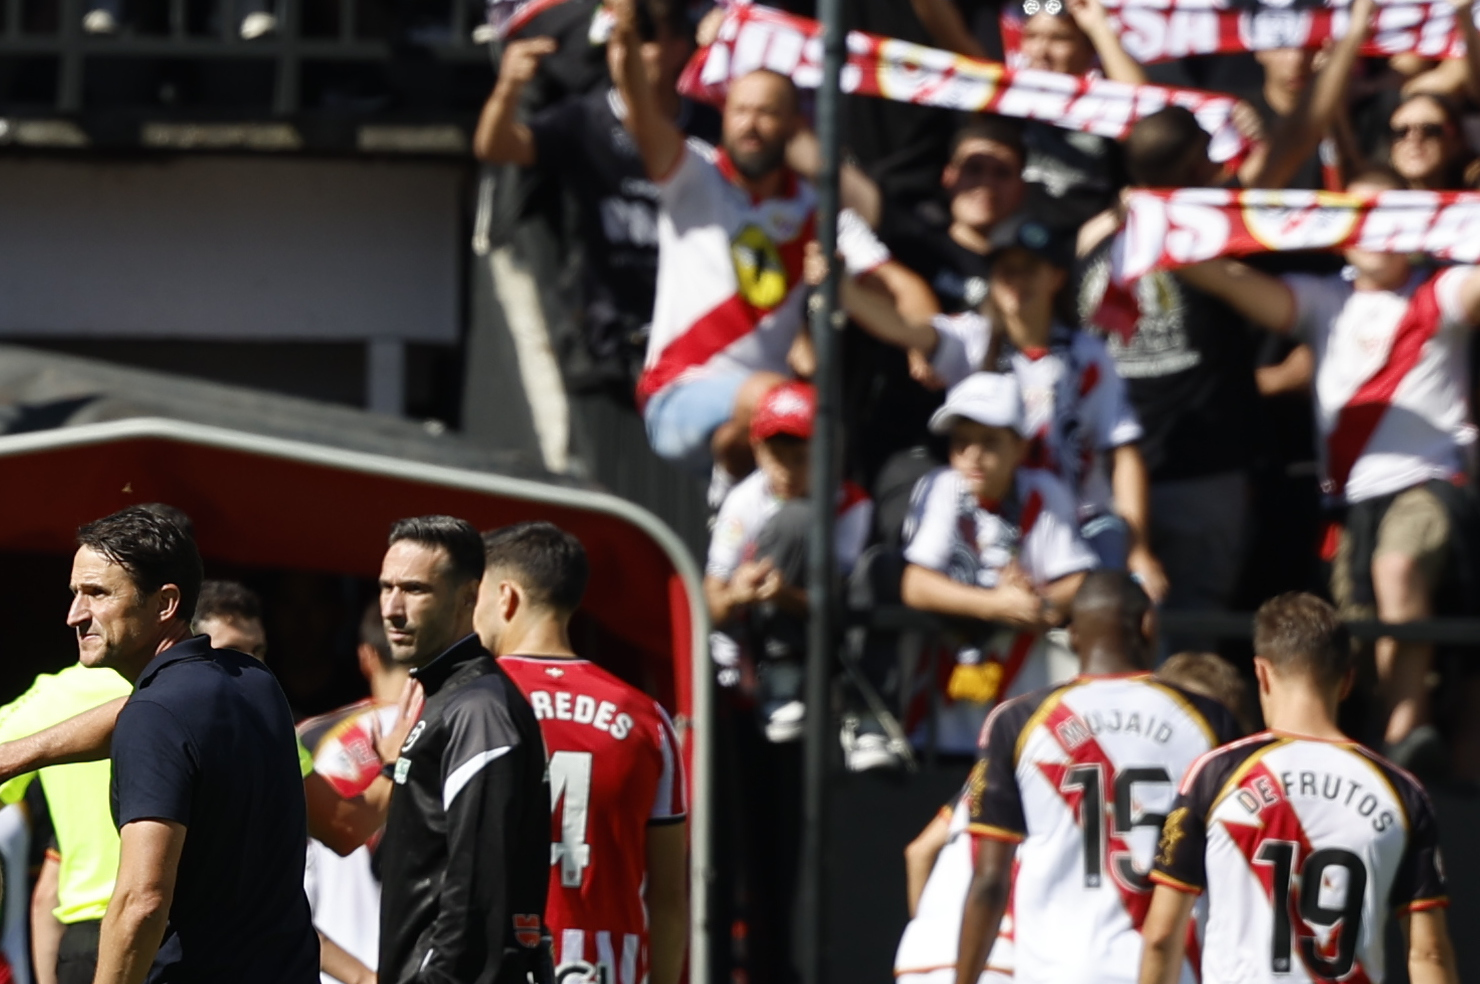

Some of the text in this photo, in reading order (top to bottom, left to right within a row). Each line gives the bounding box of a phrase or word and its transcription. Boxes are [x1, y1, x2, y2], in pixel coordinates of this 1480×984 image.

[530, 690, 635, 740] REDES
[548, 751, 593, 888] 4
[1061, 766, 1172, 893] 15
[1236, 771, 1394, 833] DE FRUTOS
[1252, 840, 1367, 979] 19
